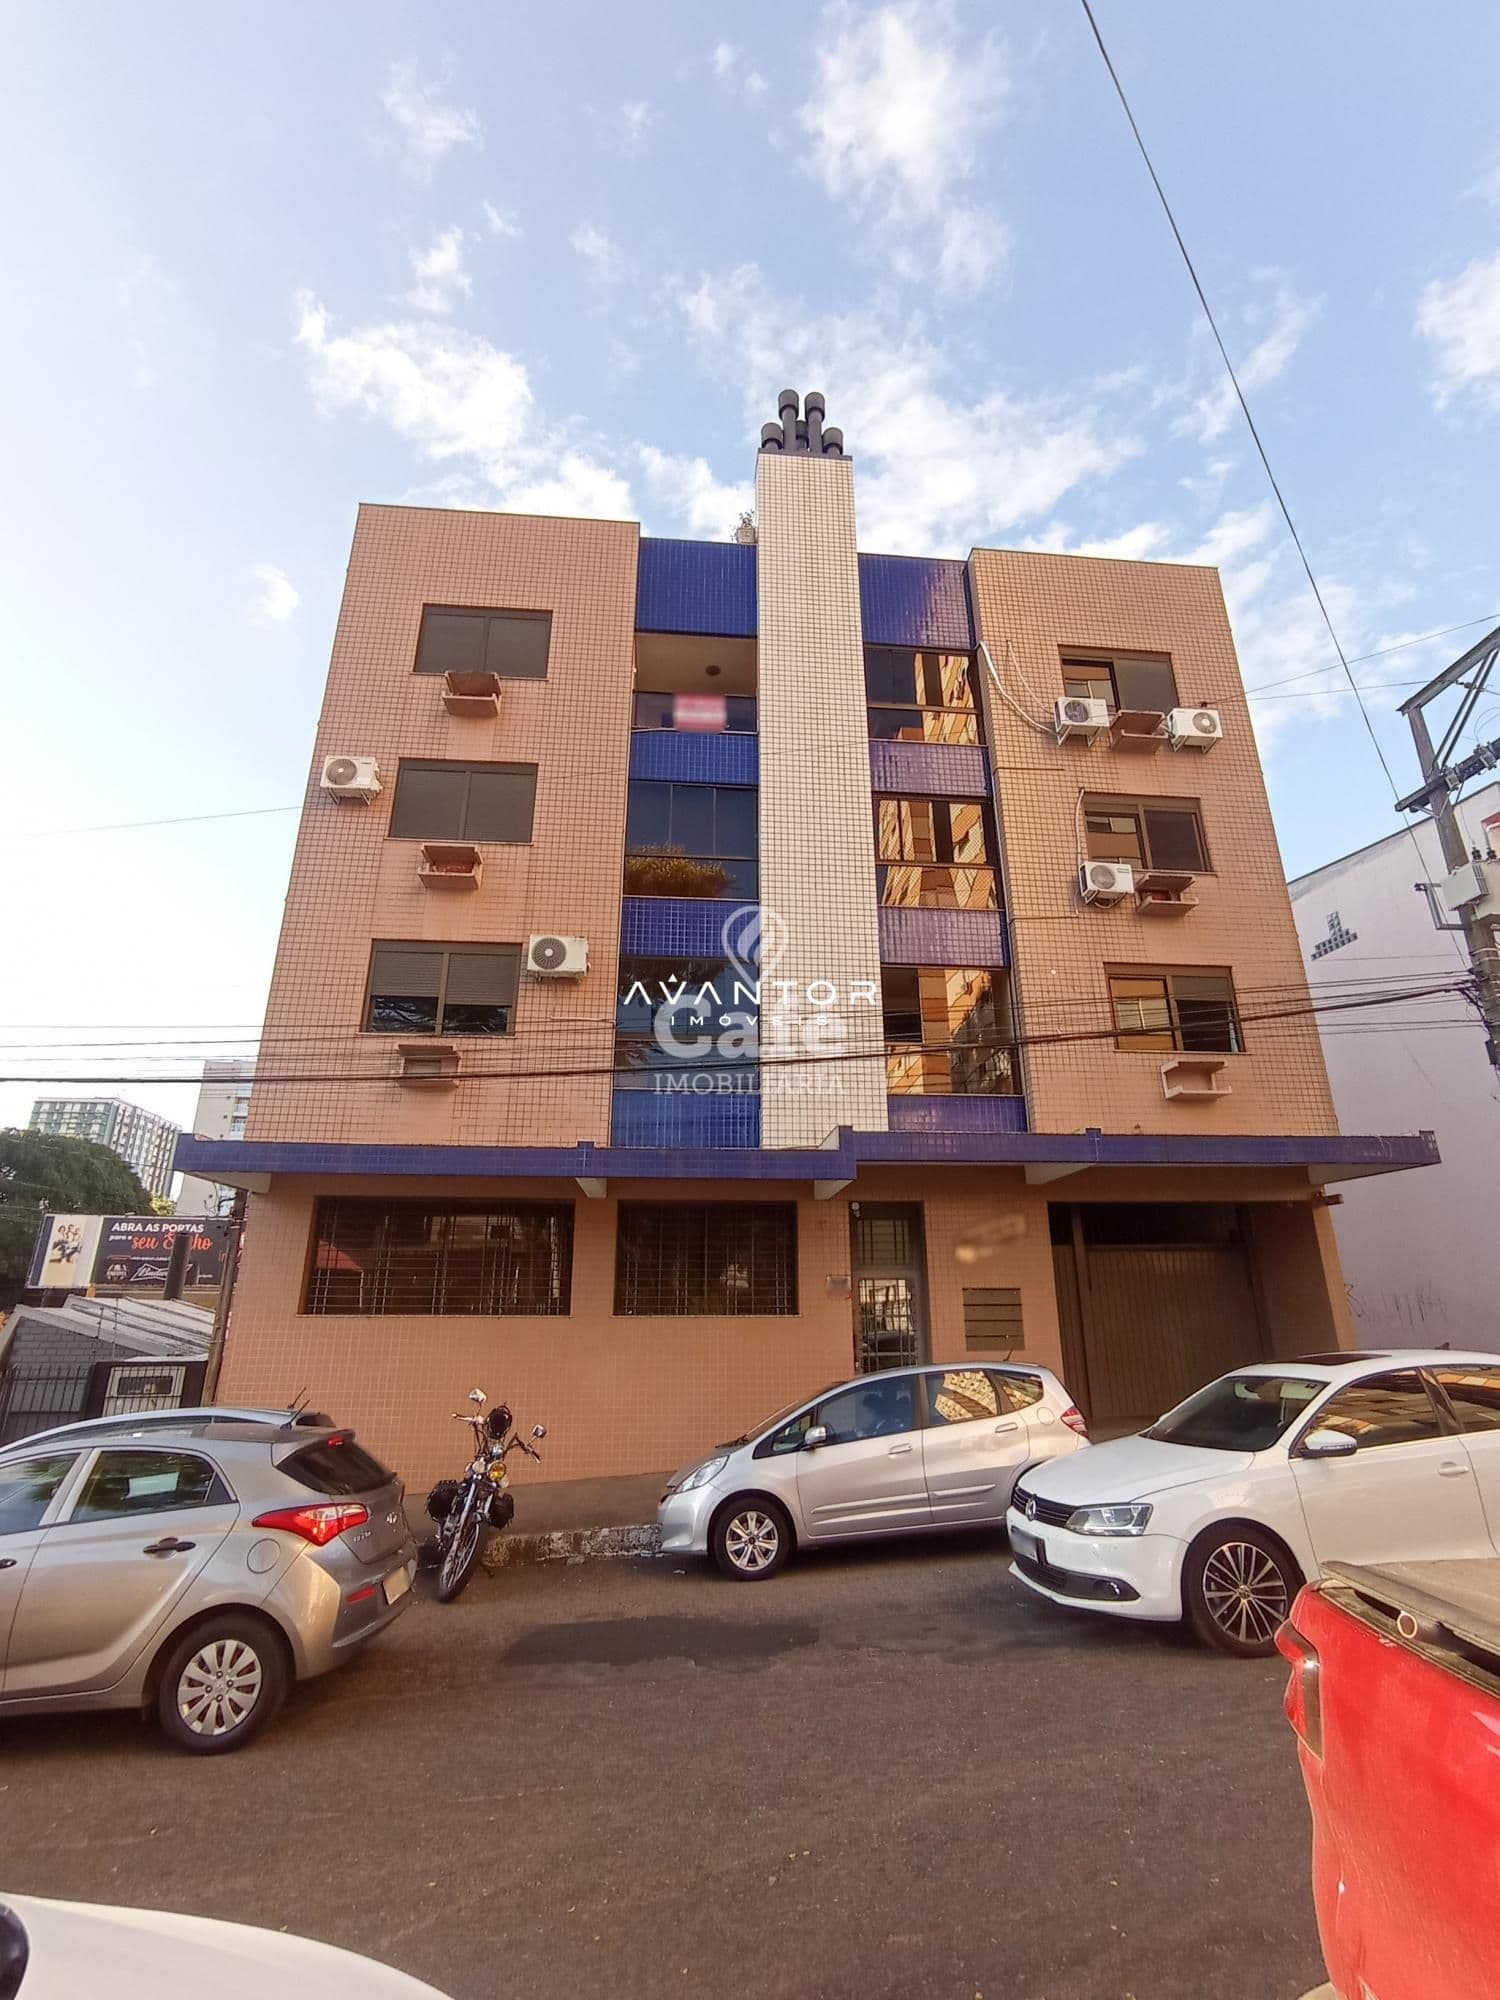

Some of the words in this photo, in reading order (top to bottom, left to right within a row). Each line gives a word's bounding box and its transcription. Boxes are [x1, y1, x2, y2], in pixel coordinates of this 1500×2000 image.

[111, 1223, 143, 1231] ABRA
[145, 1223, 160, 1232] AS
[161, 1224, 205, 1233] PORTAS
[131, 1235, 159, 1249] seu
[162, 1232, 213, 1251] Sho
